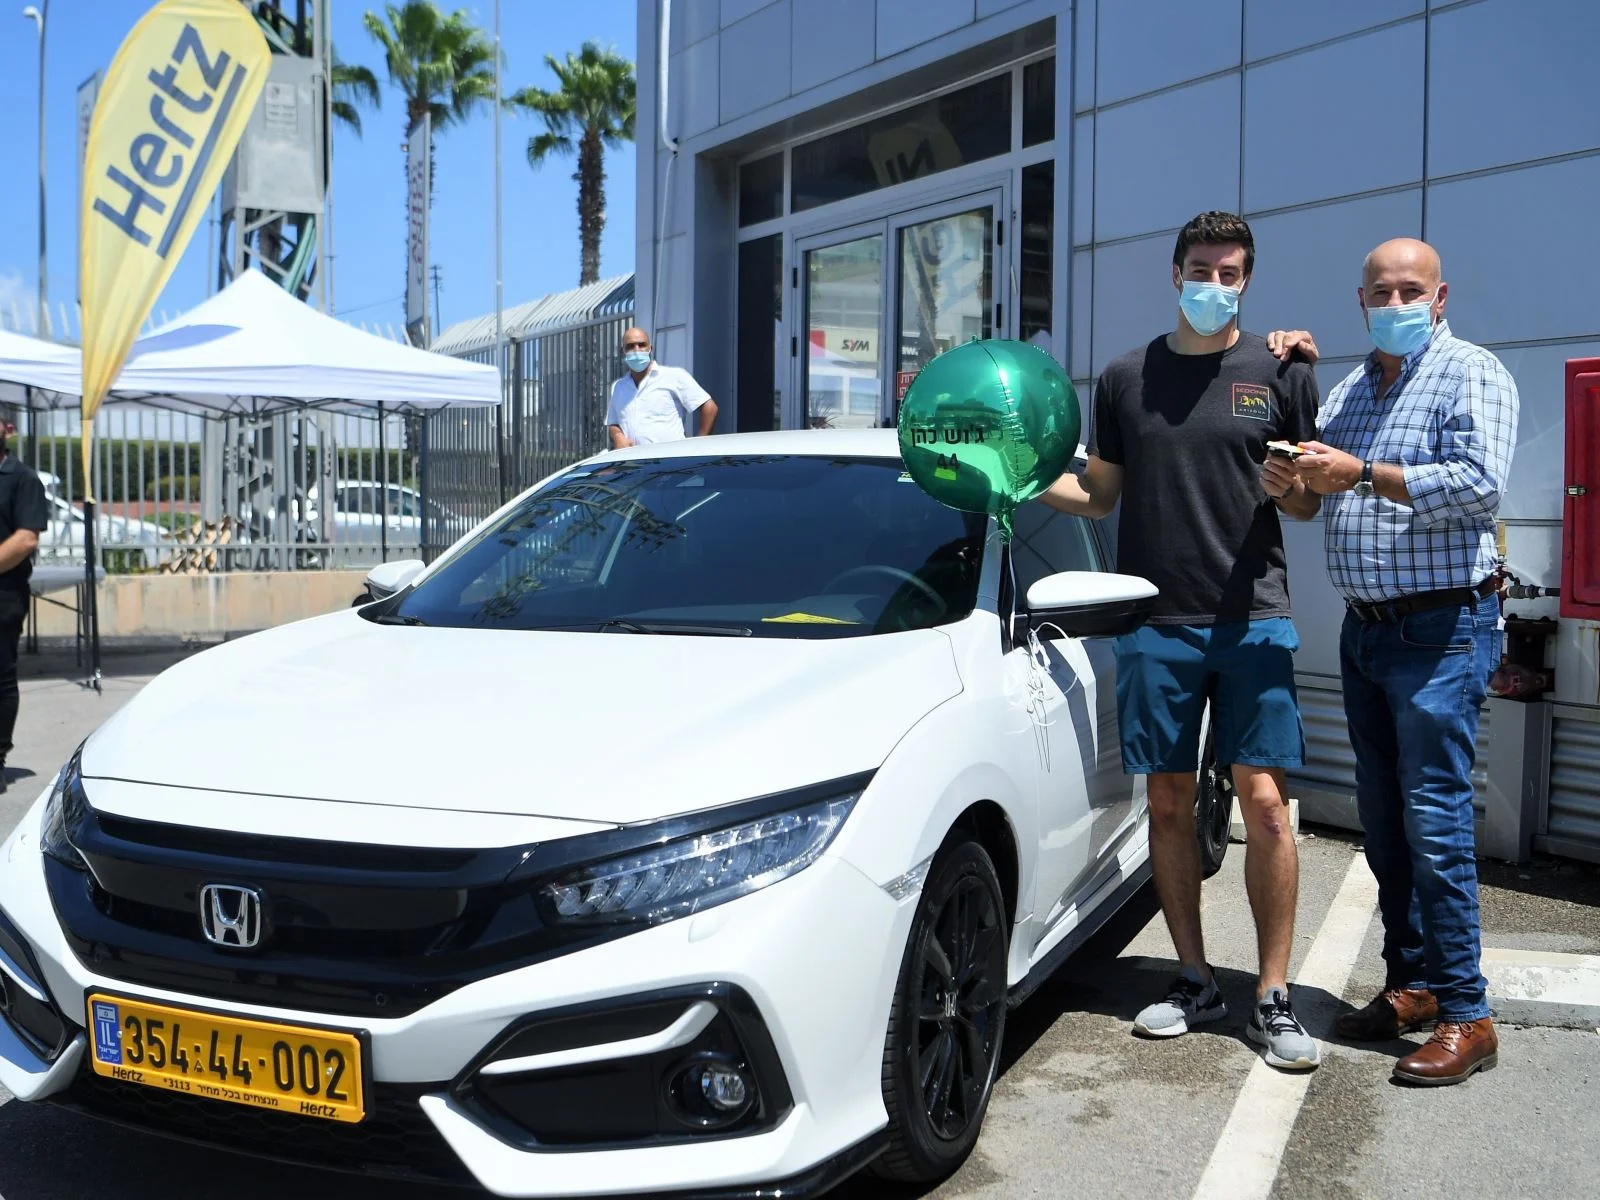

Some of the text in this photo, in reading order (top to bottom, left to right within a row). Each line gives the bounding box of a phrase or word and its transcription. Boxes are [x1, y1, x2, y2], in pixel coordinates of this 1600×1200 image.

[92, 22, 231, 248] Hertz
[1236, 387, 1267, 396] SEDONA
[911, 428, 937, 448] כהן
[937, 453, 959, 469] 44
[101, 1021, 115, 1047] IL
[196, 1084, 220, 1096] מחיר
[221, 1087, 241, 1099] בכל
[243, 1094, 279, 1106] מנצחים
